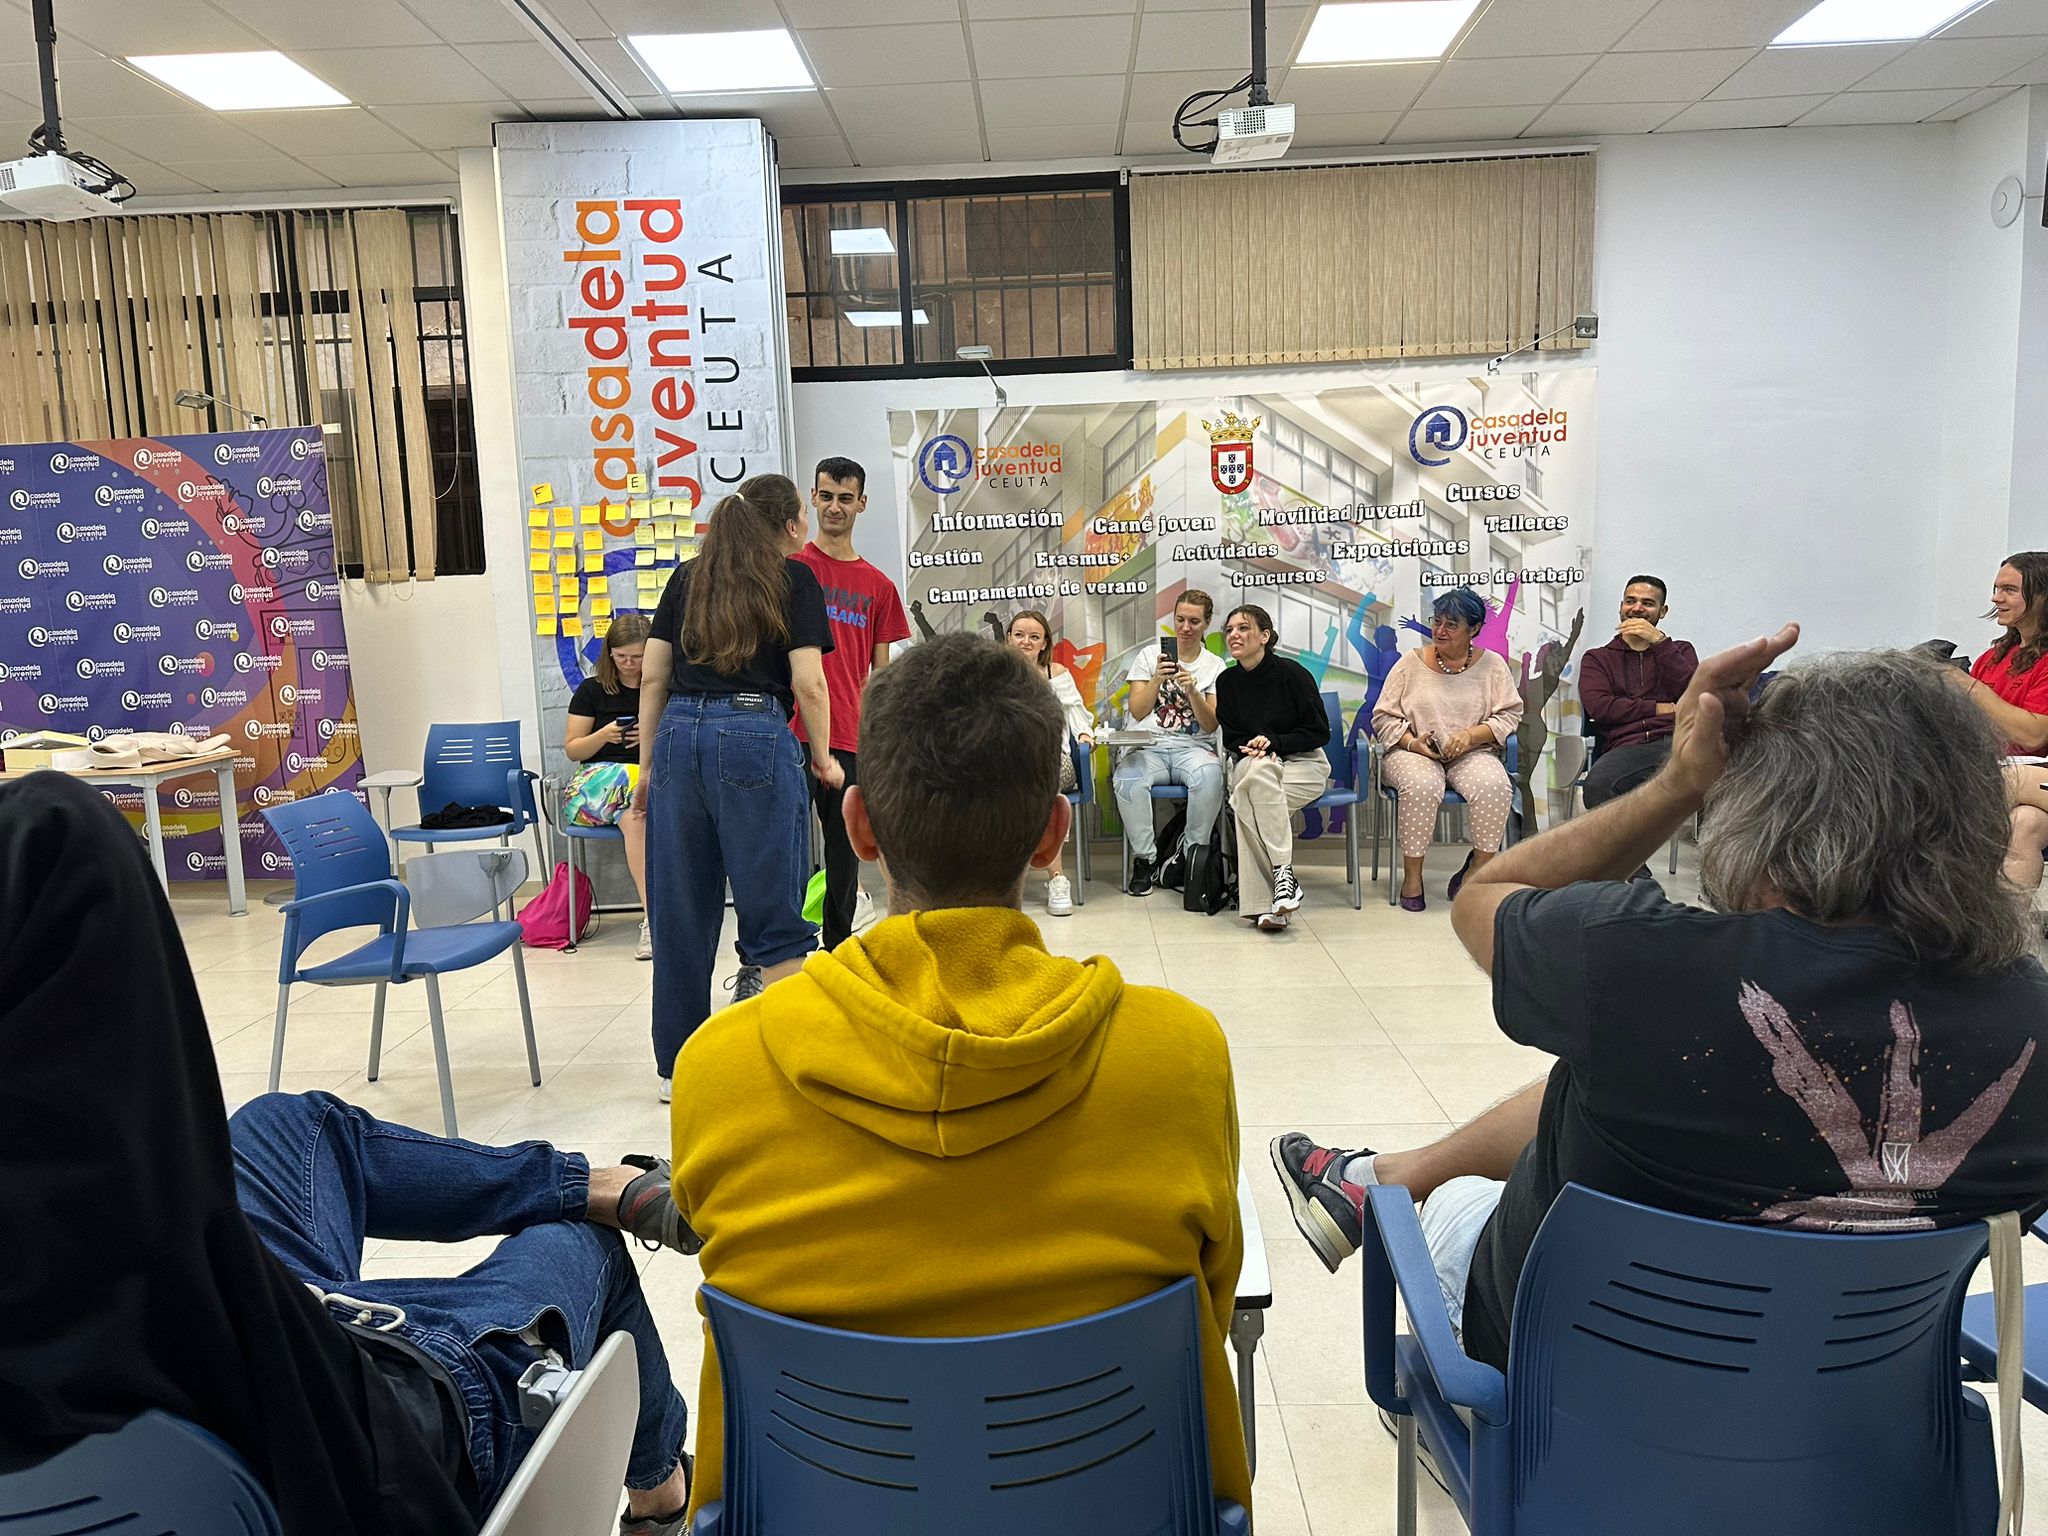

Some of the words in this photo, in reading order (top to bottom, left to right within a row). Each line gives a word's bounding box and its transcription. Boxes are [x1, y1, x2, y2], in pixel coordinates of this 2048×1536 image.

[698, 254, 746, 483] CEUTA
[1470, 408, 1568, 430] casadela
[1468, 425, 1567, 452] juventud
[975, 441, 1061, 460] casadela
[1484, 445, 1550, 460] CEUTA
[975, 457, 1062, 480] juventud
[534, 486, 545, 498] F
[631, 476, 639, 488] E
[990, 476, 1048, 488] CEUTA
[1447, 483, 1520, 502] Cursos
[932, 508, 1064, 532] Información
[1259, 505, 1352, 526] Movilidad
[1356, 500, 1425, 524] juvenil
[1094, 516, 1153, 534] Carné
[1158, 515, 1216, 536] joven
[1485, 515, 1568, 533] Talleres
[909, 548, 982, 568] Gestión
[1036, 552, 1130, 568] Erasmus+
[1173, 542, 1278, 561] Actividades
[1332, 538, 1470, 562] Exposiciones
[1232, 570, 1326, 588] Concursos
[1420, 571, 1490, 588] Campos
[1494, 569, 1516, 584] de
[1522, 567, 1584, 586] trabajo
[929, 582, 1054, 604] Campamentos
[1060, 580, 1080, 595] de
[1086, 580, 1148, 594] verano
